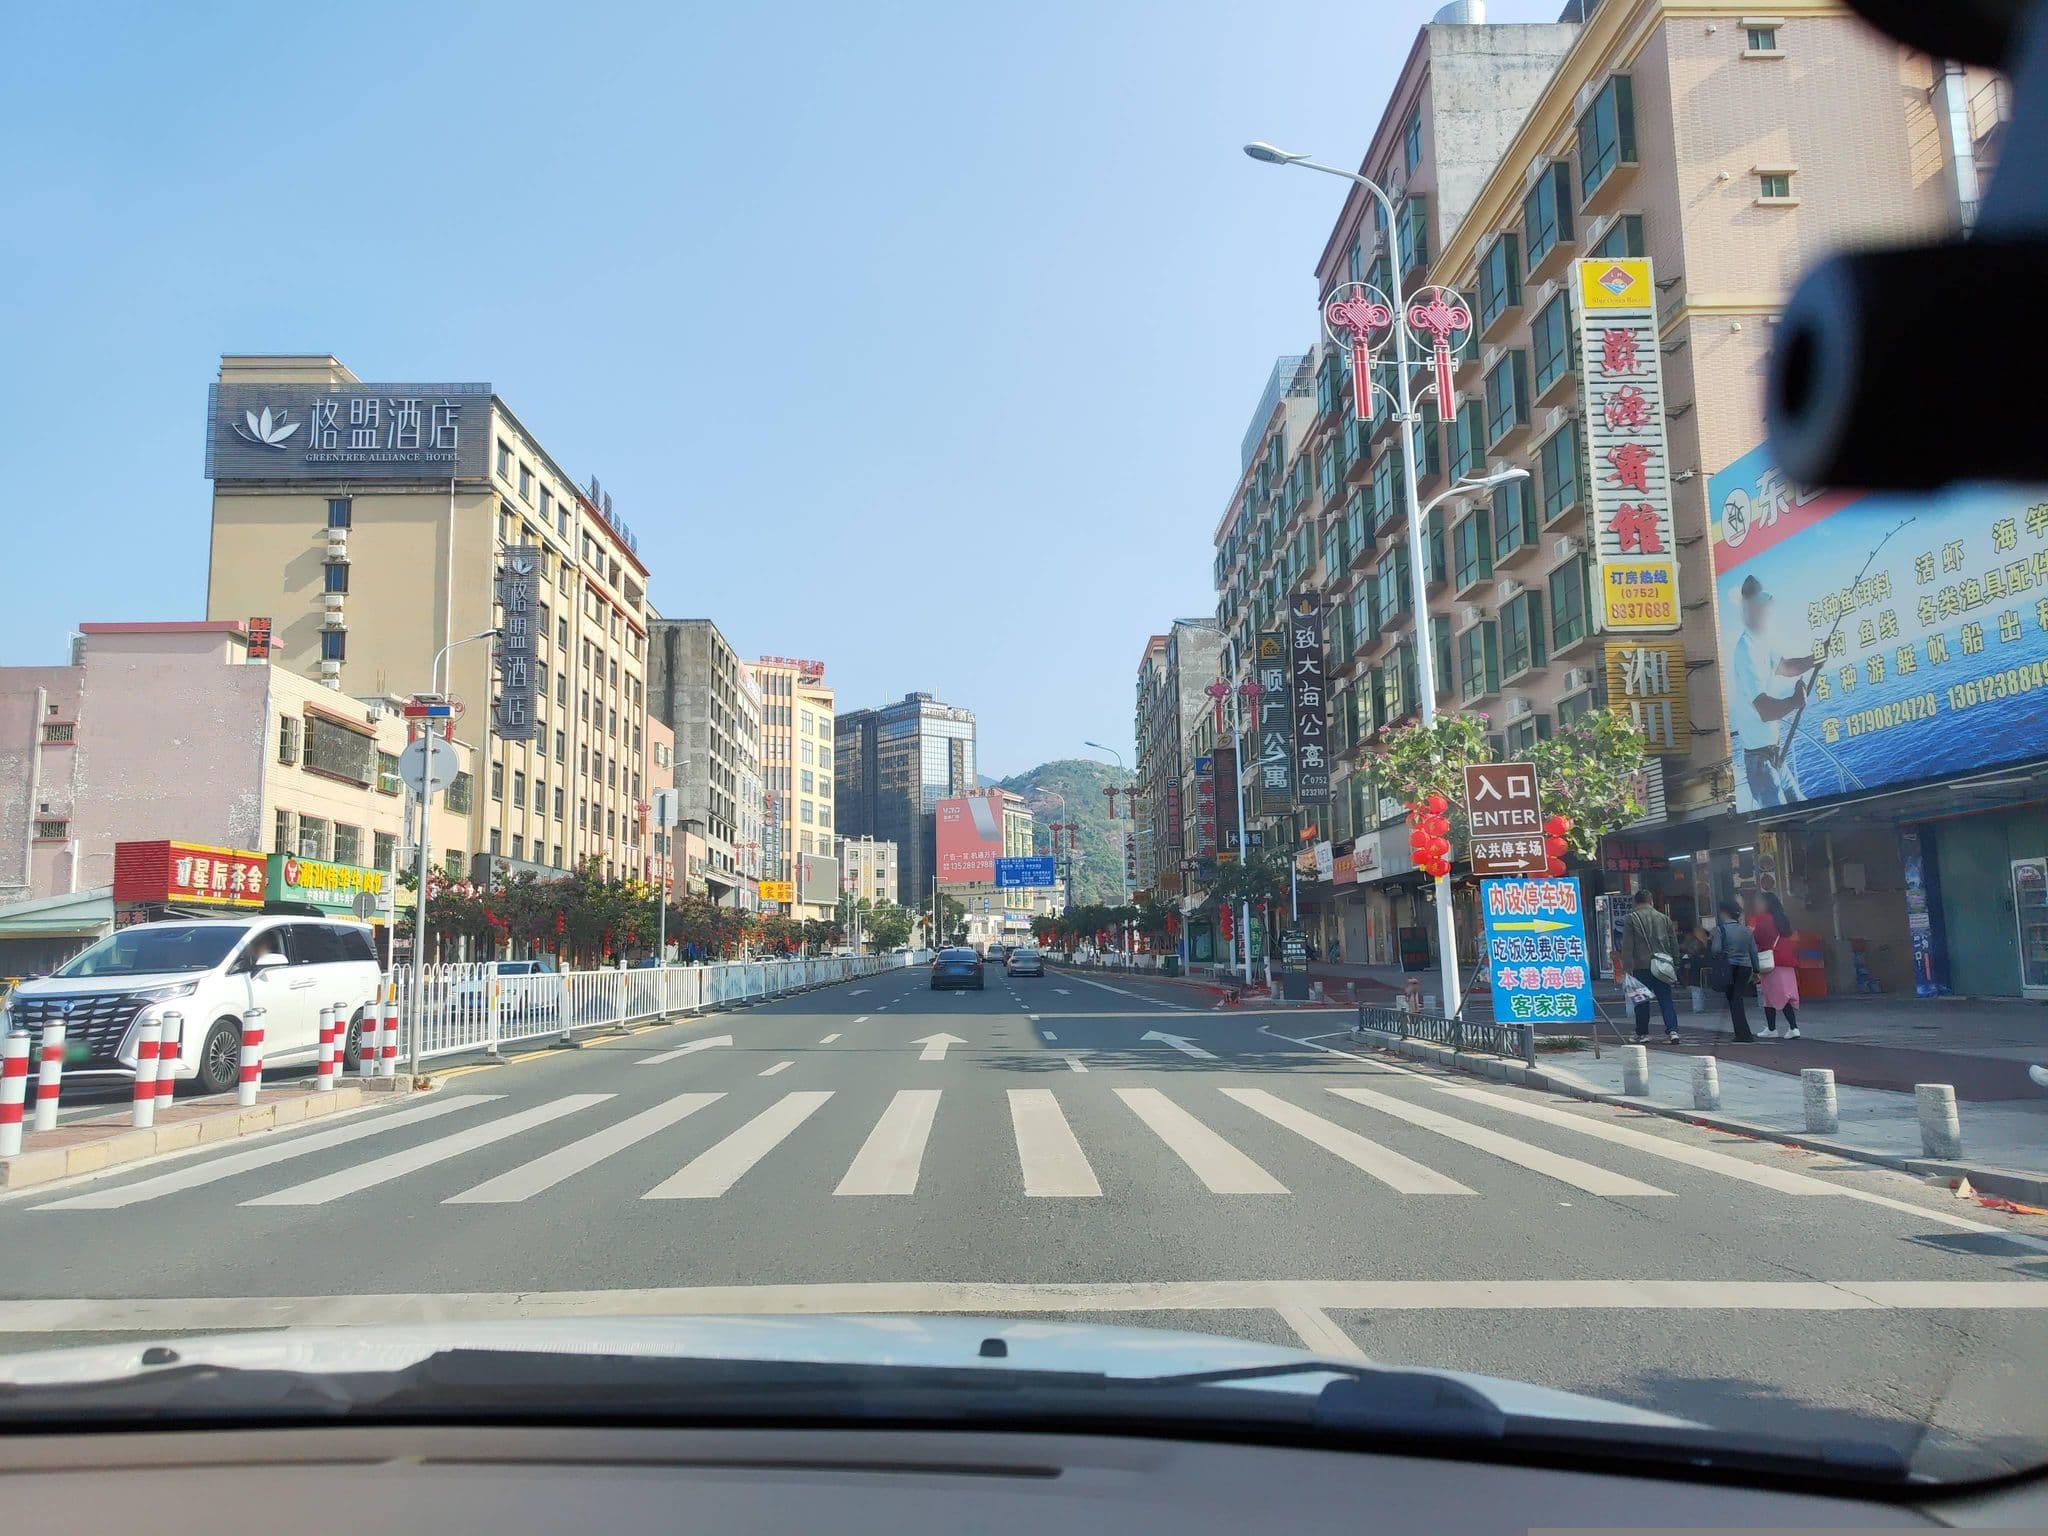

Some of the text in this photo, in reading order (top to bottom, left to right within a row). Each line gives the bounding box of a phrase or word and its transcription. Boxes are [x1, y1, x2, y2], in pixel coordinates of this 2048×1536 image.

[307, 398, 462, 450] 格盟酒店
[305, 453, 459, 462] GREENTREE ALLIANCE HOTEL
[1610, 570, 1669, 585] 订房热线
[1807, 569, 1893, 630] 各种鱼饵料
[1914, 538, 1966, 586] 活虾
[1621, 586, 1660, 600] (0752)
[1611, 601, 1671, 619] 8337688
[1811, 630, 1847, 665] 鱼钩
[1858, 608, 1900, 649] 鱼线
[506, 580, 528, 727] 格盟酒店
[1294, 626, 1325, 770] 致大海公寓
[1845, 692, 1937, 737] 13790824728
[1261, 668, 1288, 789] 顺广公寓
[1301, 787, 1328, 797] 8232101
[1311, 775, 1327, 785] 0752
[1475, 775, 1530, 801] 入口
[1472, 809, 1536, 827] ENTER
[1475, 840, 1542, 859] 公共停车场
[192, 858, 263, 893] 星辰茶舍
[1488, 882, 1578, 914] 内设停车场
[1492, 936, 1583, 962] 吃饭免费停车
[1498, 966, 1585, 990] 本港海鲜
[1511, 994, 1578, 1017] 客家菜
